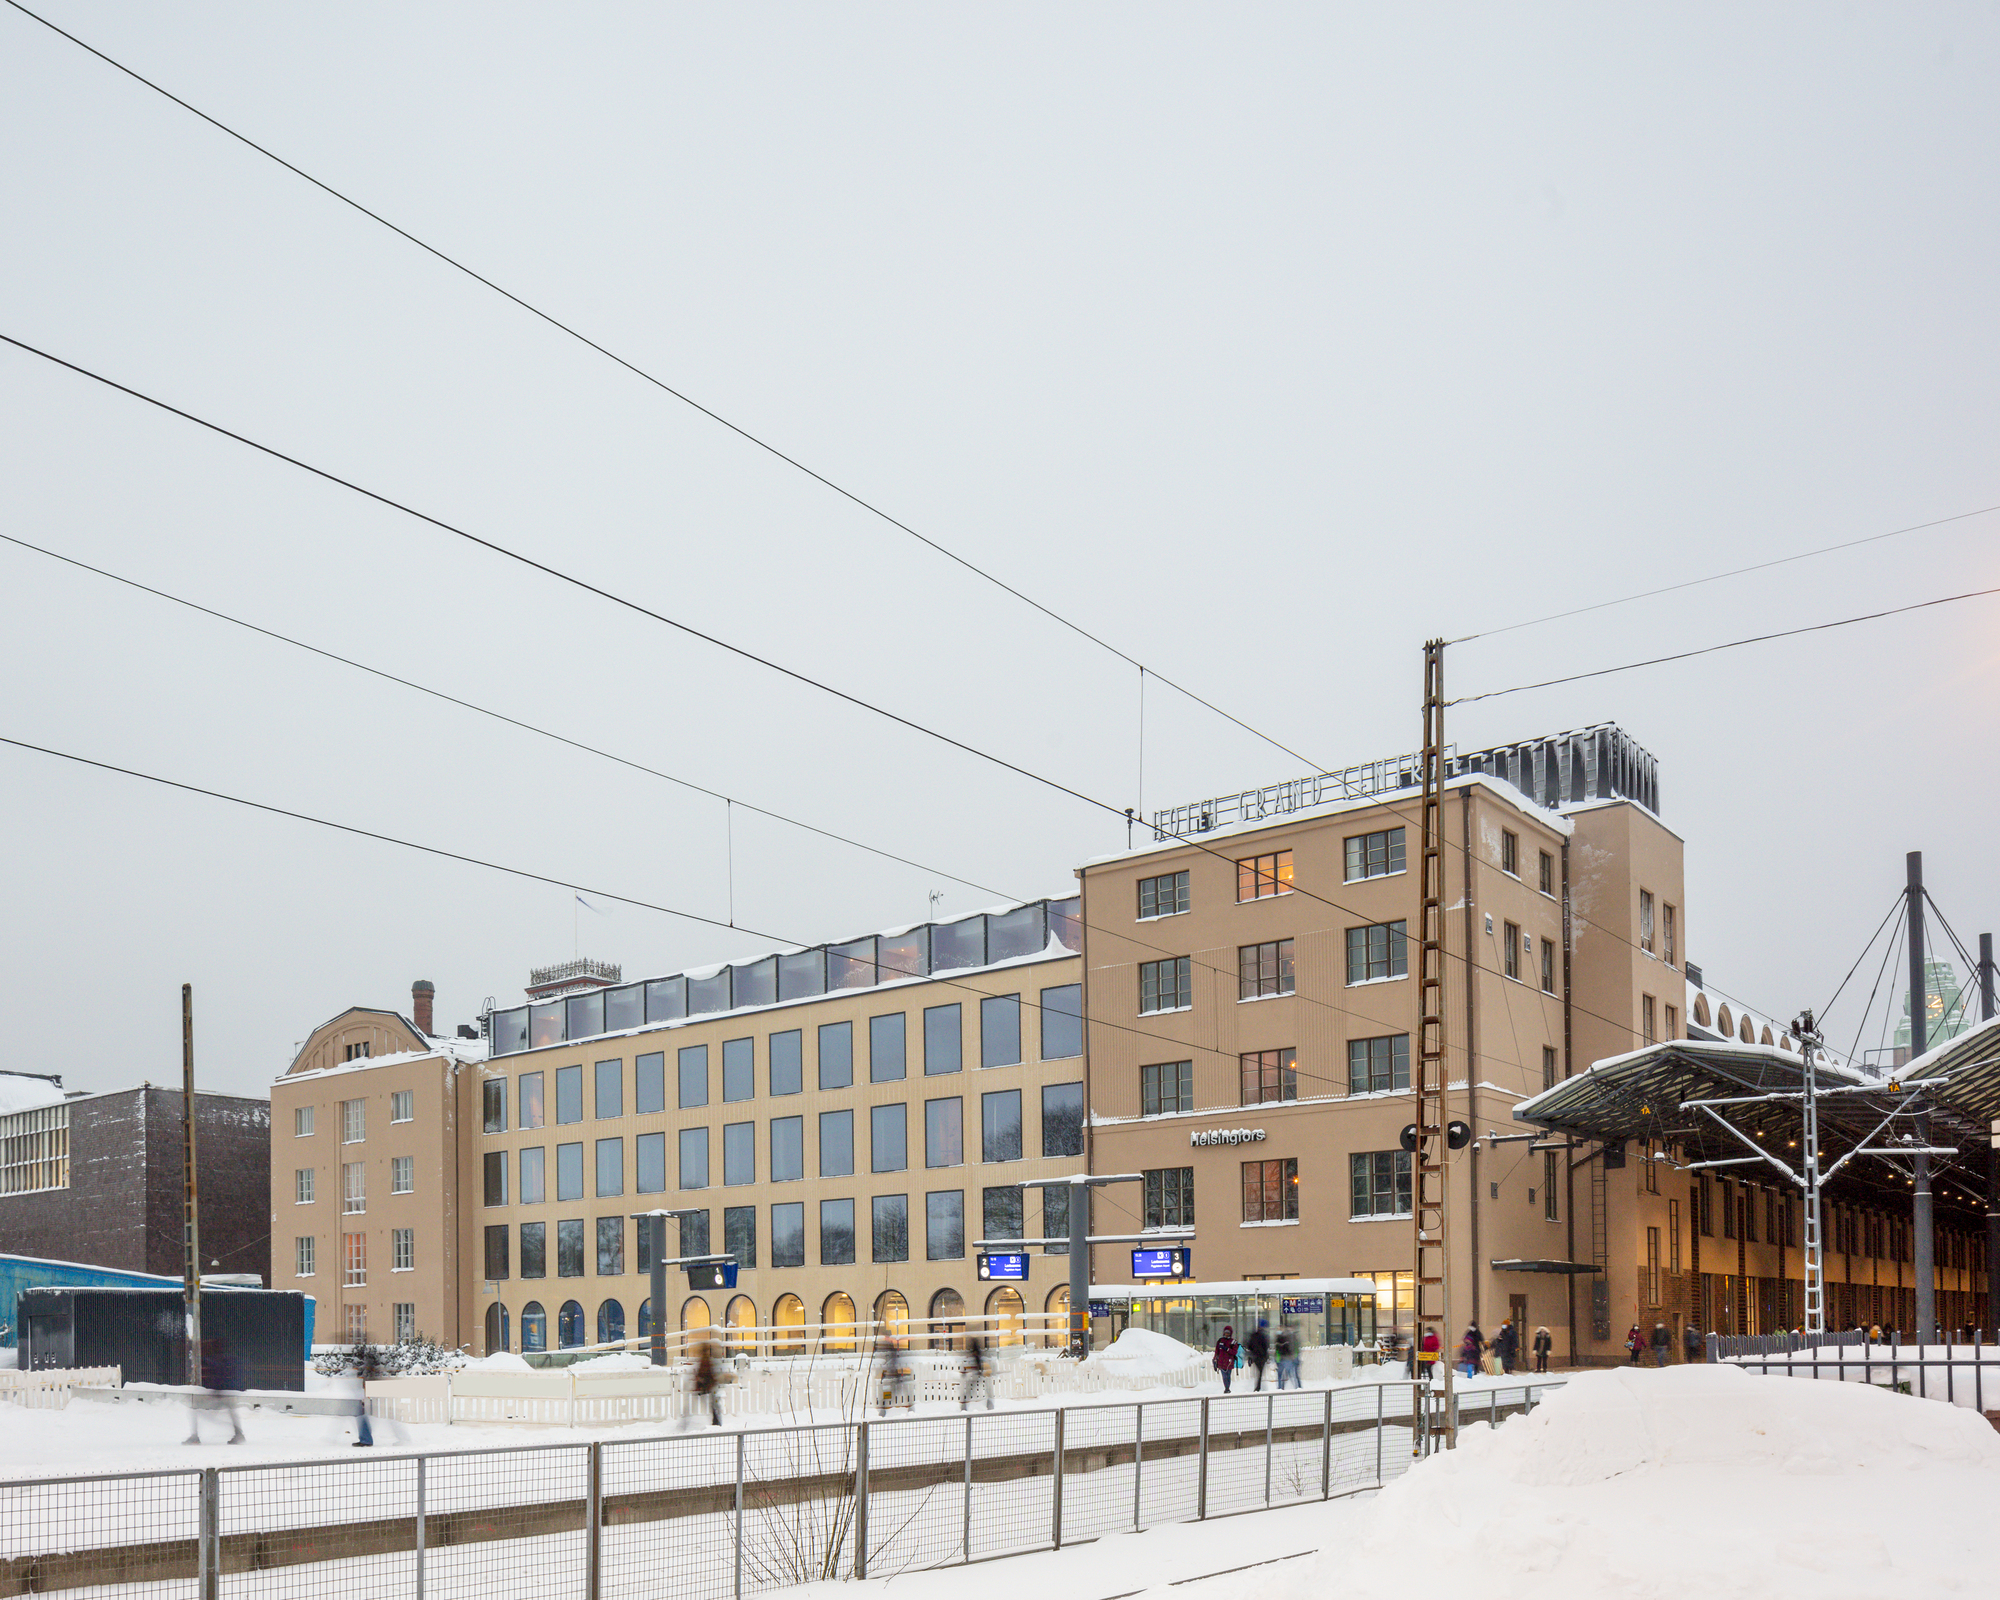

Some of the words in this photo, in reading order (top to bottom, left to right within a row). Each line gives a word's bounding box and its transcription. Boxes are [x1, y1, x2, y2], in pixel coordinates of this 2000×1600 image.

[1152, 797, 1220, 842] HOTEL
[1237, 774, 1322, 821] GRAND
[1888, 1084, 1900, 1092] 1A
[1641, 1106, 1651, 1115] 1A
[1190, 1128, 1266, 1147] Helsingfors
[1174, 1252, 1180, 1261] 3
[982, 1258, 988, 1266] 2
